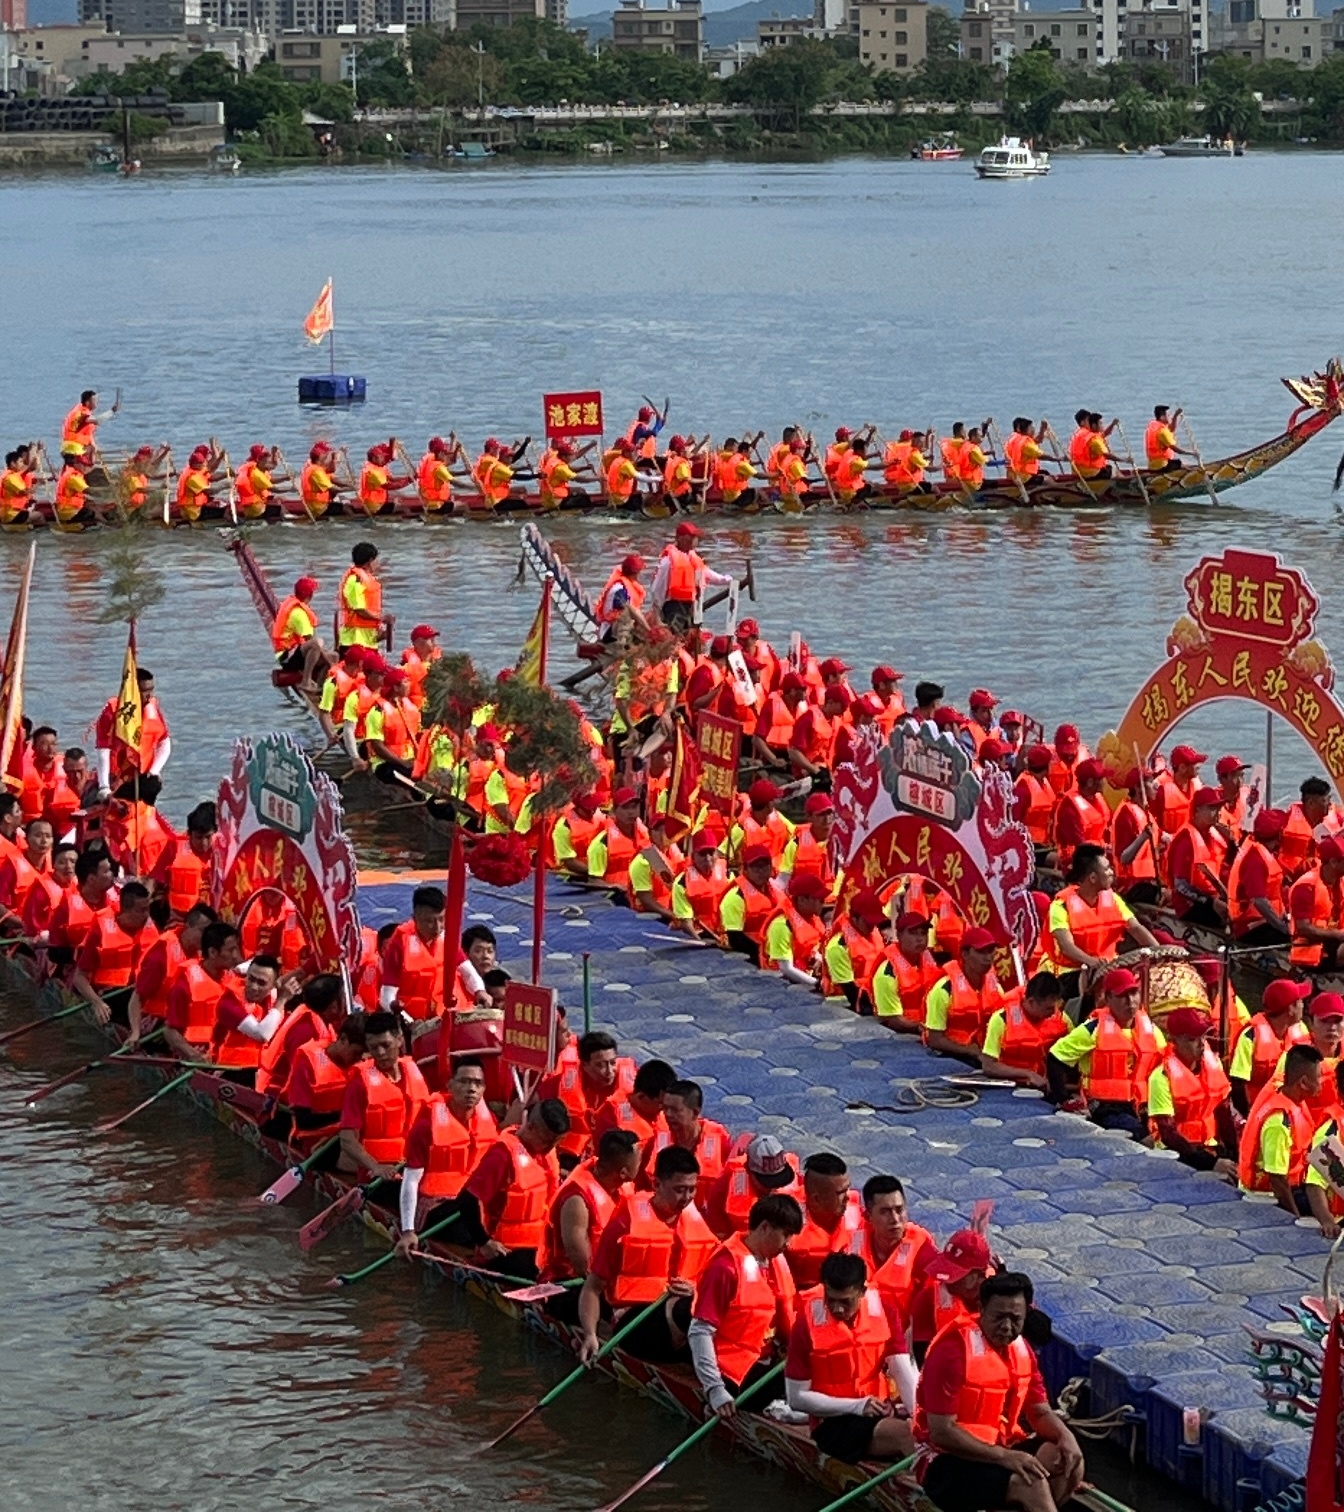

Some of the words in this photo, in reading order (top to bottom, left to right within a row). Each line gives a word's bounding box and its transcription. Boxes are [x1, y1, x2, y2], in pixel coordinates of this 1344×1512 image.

[1209, 571, 1285, 626] 揭东区
[700, 722, 734, 761] 榕城区
[909, 780, 945, 815] 榕城区
